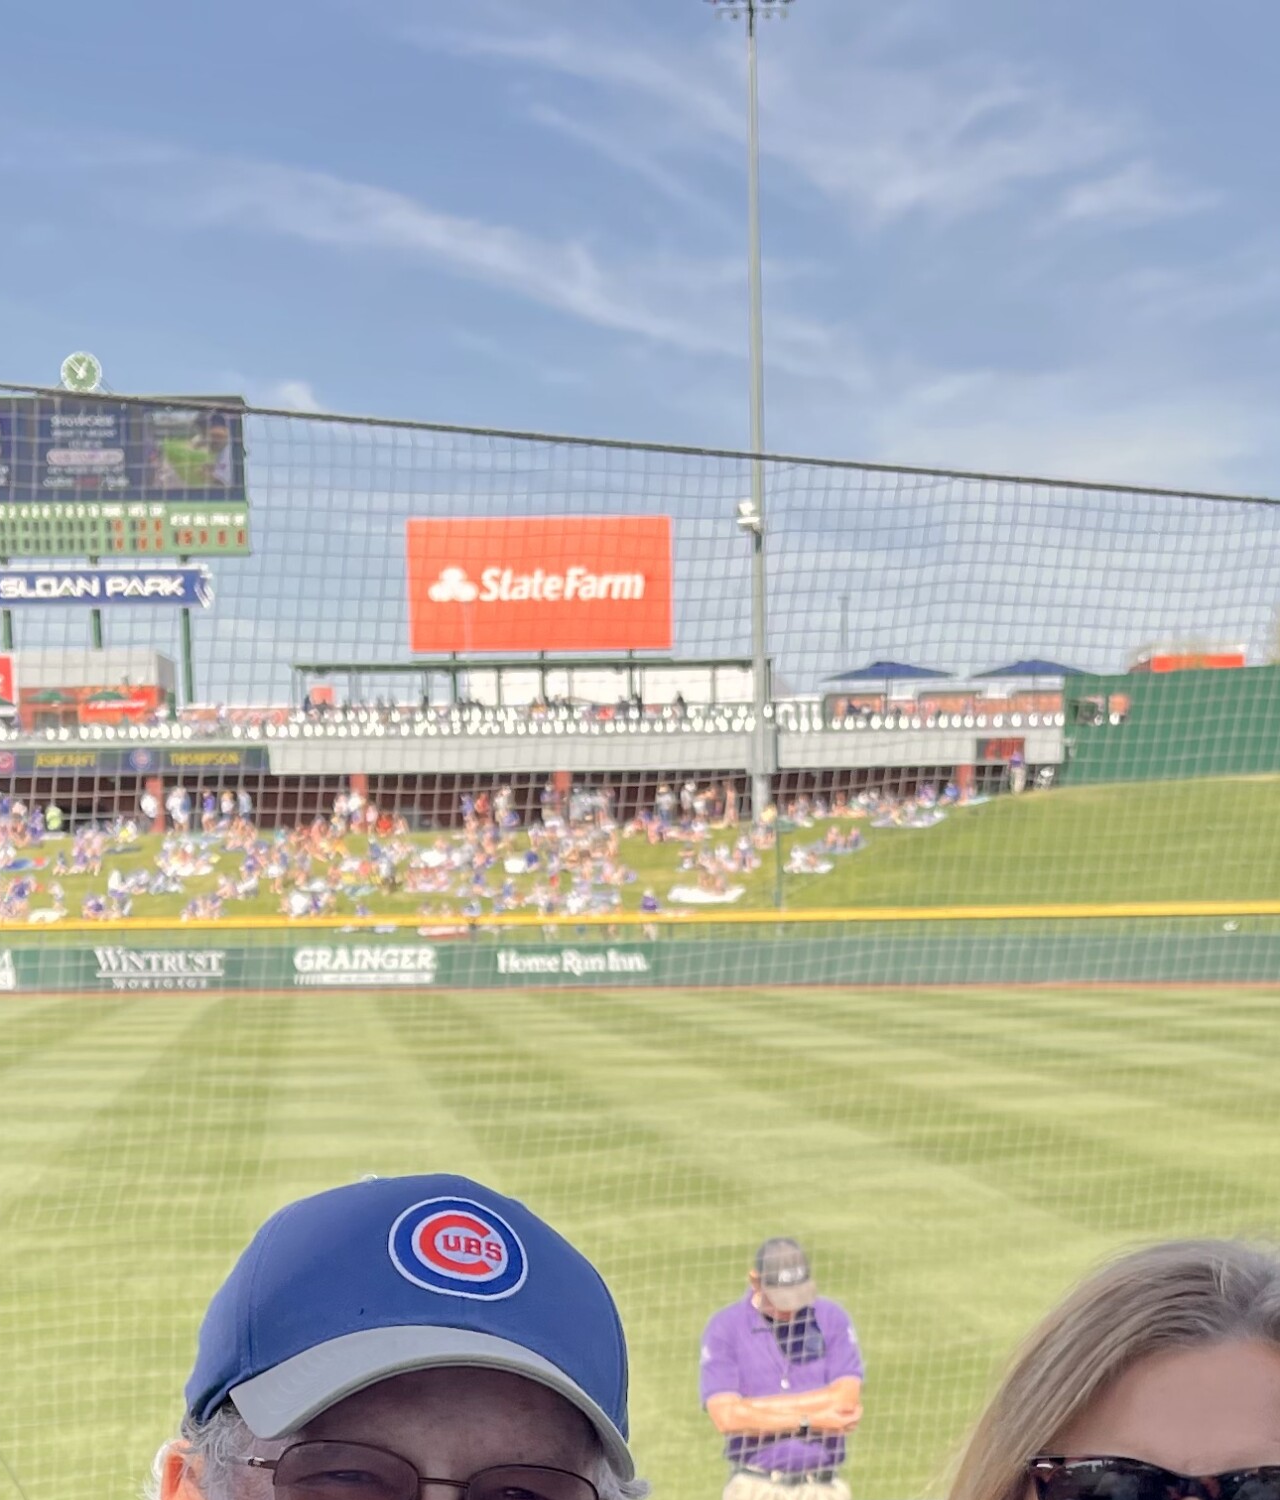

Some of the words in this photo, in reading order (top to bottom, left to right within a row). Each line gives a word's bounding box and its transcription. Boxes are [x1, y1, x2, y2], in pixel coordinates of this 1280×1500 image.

[0, 575, 100, 598] SLOAN
[105, 574, 185, 597] PARK
[293, 946, 436, 971] GRAINGER
[497, 949, 560, 973] Home
[561, 949, 605, 976] Run
[419, 1214, 502, 1276] CUBS
